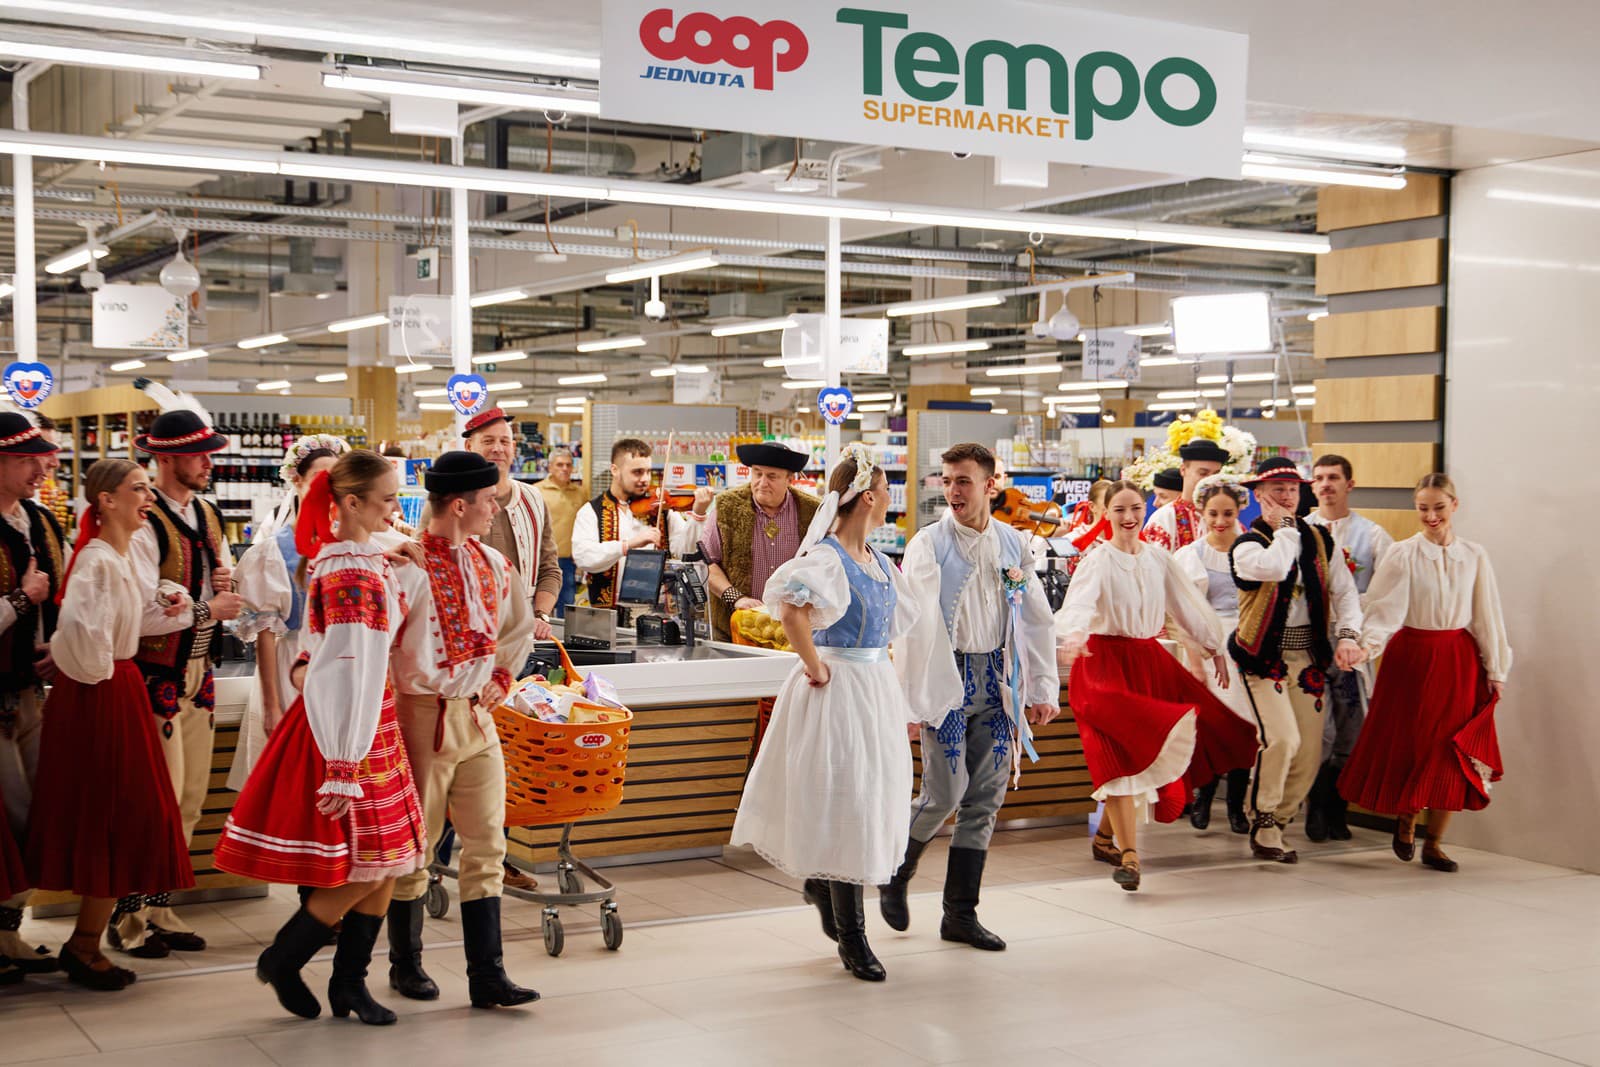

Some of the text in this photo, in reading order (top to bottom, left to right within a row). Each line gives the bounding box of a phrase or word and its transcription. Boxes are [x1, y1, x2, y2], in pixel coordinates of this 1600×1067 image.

[640, 8, 809, 91] coop
[640, 65, 744, 88] JEDNOTA
[837, 9, 1216, 140] Tempo
[863, 99, 1070, 139] SUPERMARKET
[771, 418, 806, 436] BIO
